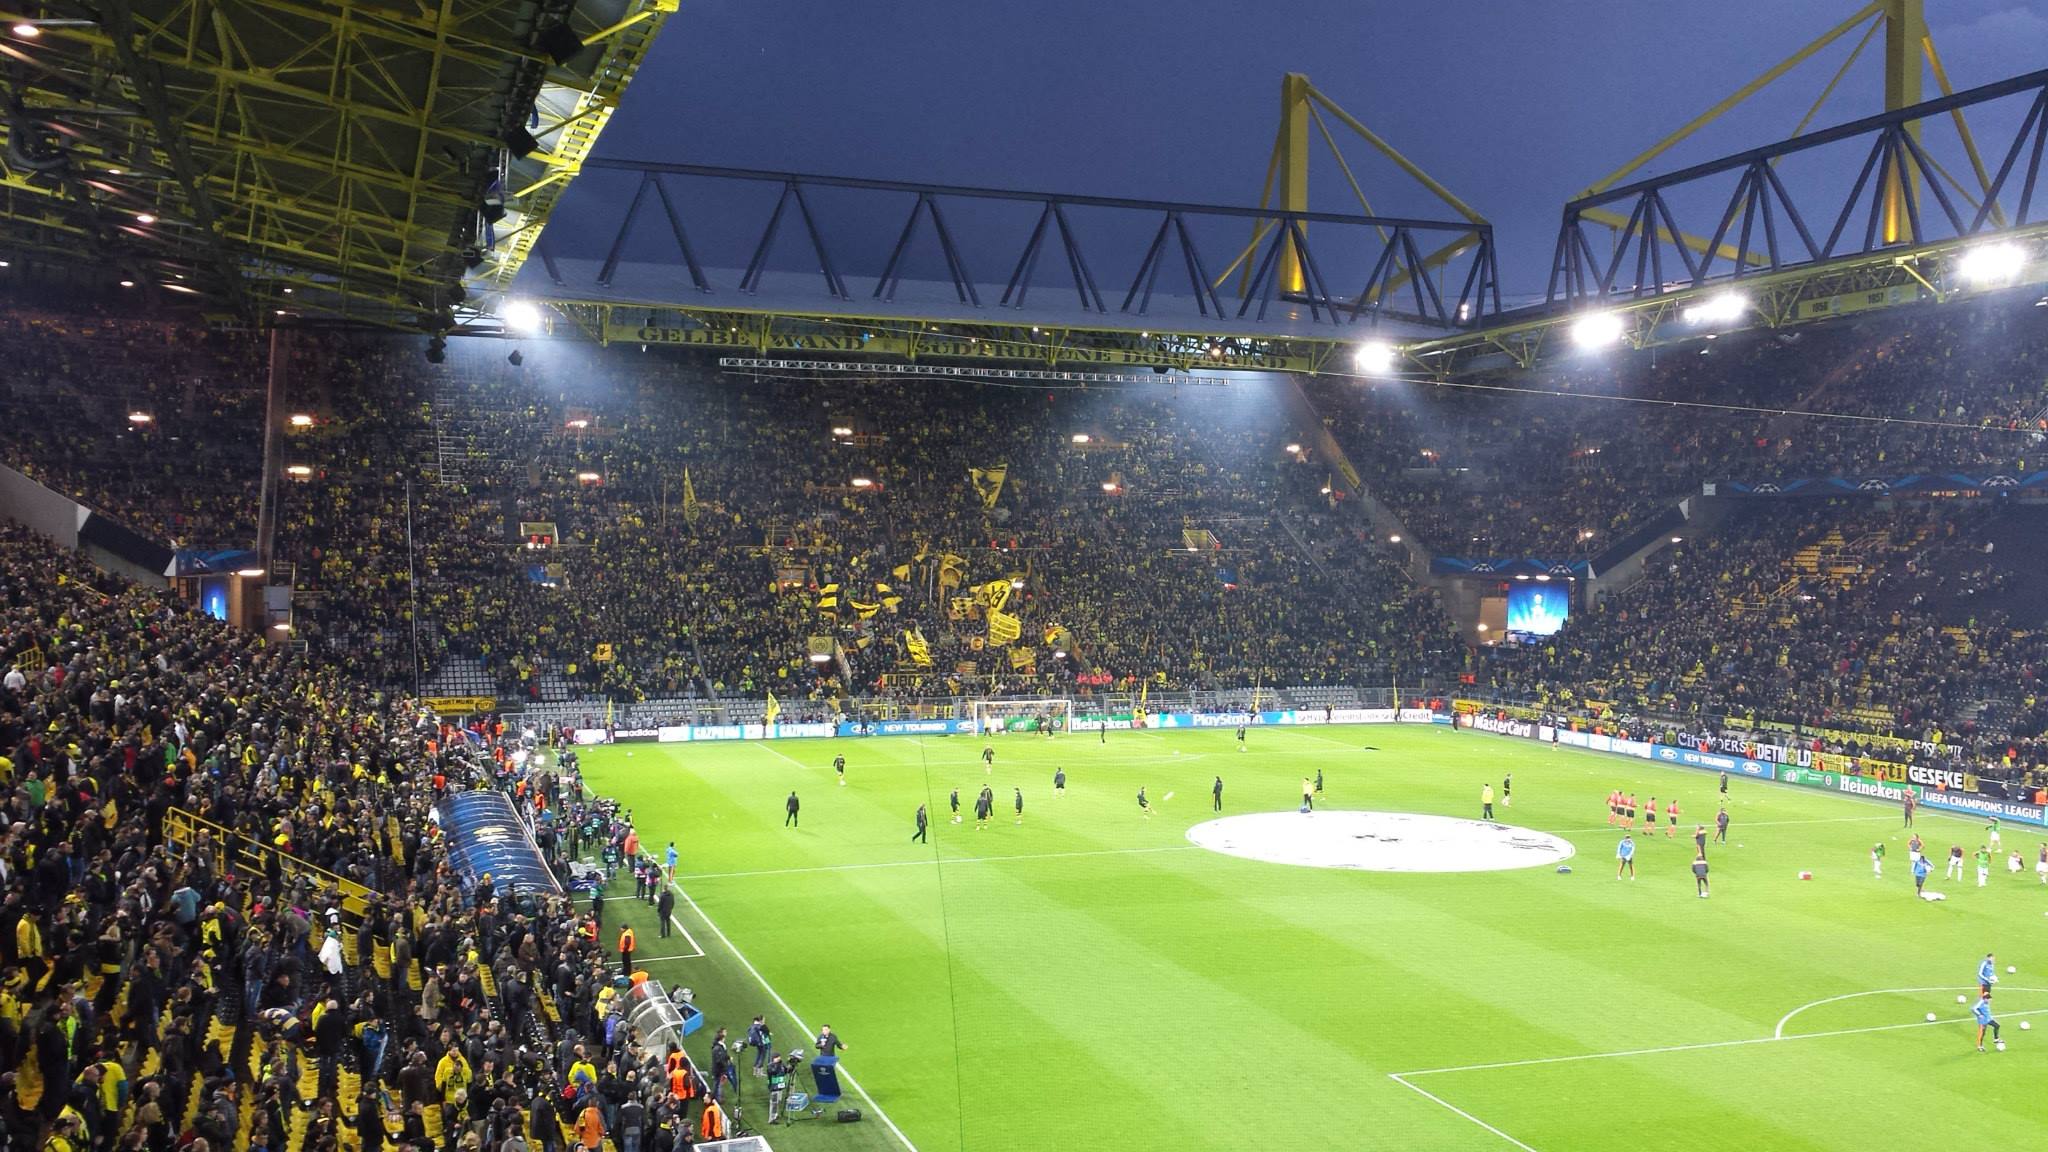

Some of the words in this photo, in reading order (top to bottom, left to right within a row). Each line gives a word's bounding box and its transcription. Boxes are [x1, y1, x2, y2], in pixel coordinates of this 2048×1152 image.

[637, 327, 750, 345] GELBE
[771, 334, 865, 349] WAND
[884, 723, 903, 732] NEW
[1473, 713, 1531, 738] MasterCard
[1683, 752, 1700, 763] NEW
[1839, 774, 1902, 801] Heineken
[1908, 765, 1963, 790] GESEKE
[1925, 791, 1949, 805] UEFA
[1949, 795, 2002, 814] CHAMPIONS
[2004, 804, 2043, 821] LEAGUE
